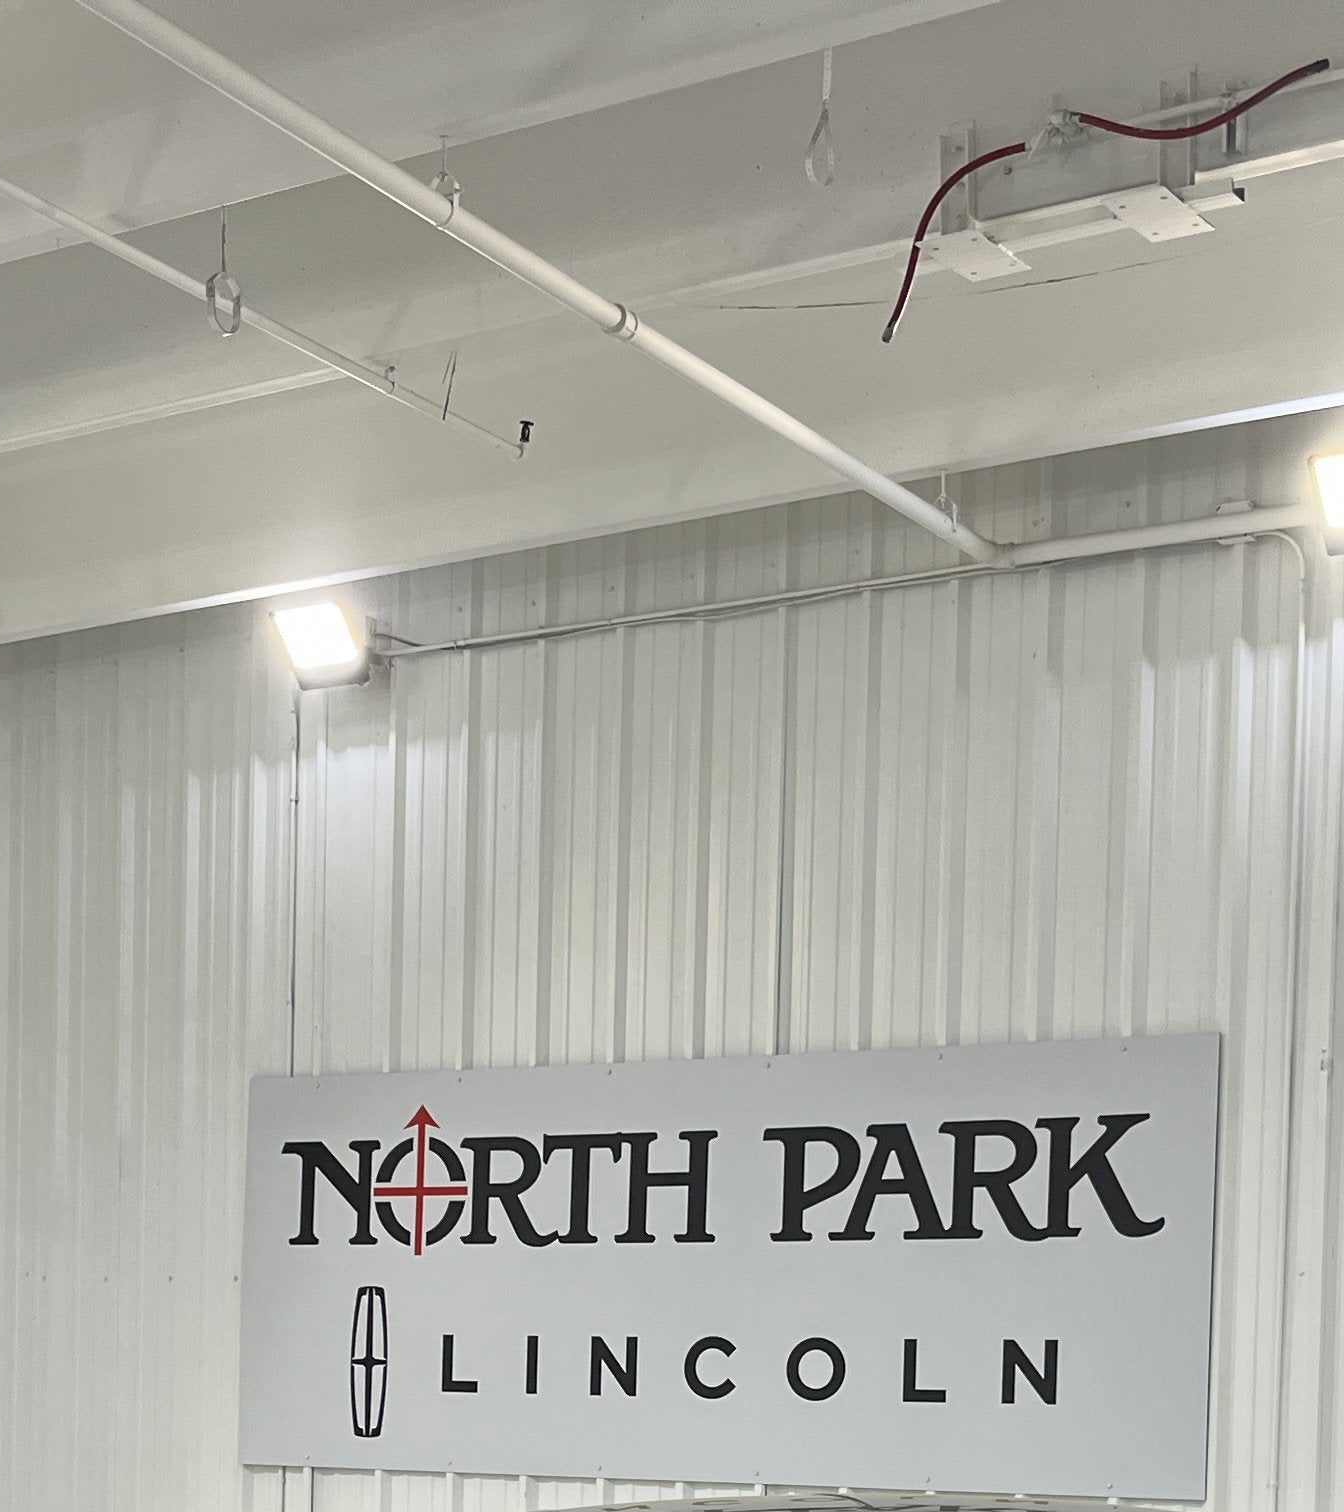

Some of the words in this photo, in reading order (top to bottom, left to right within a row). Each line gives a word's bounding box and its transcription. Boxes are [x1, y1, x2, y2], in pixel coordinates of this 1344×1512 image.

[281, 1128, 718, 1249] NORTH
[762, 1112, 1165, 1242] PARK
[441, 1334, 1059, 1405] LINCOLN
